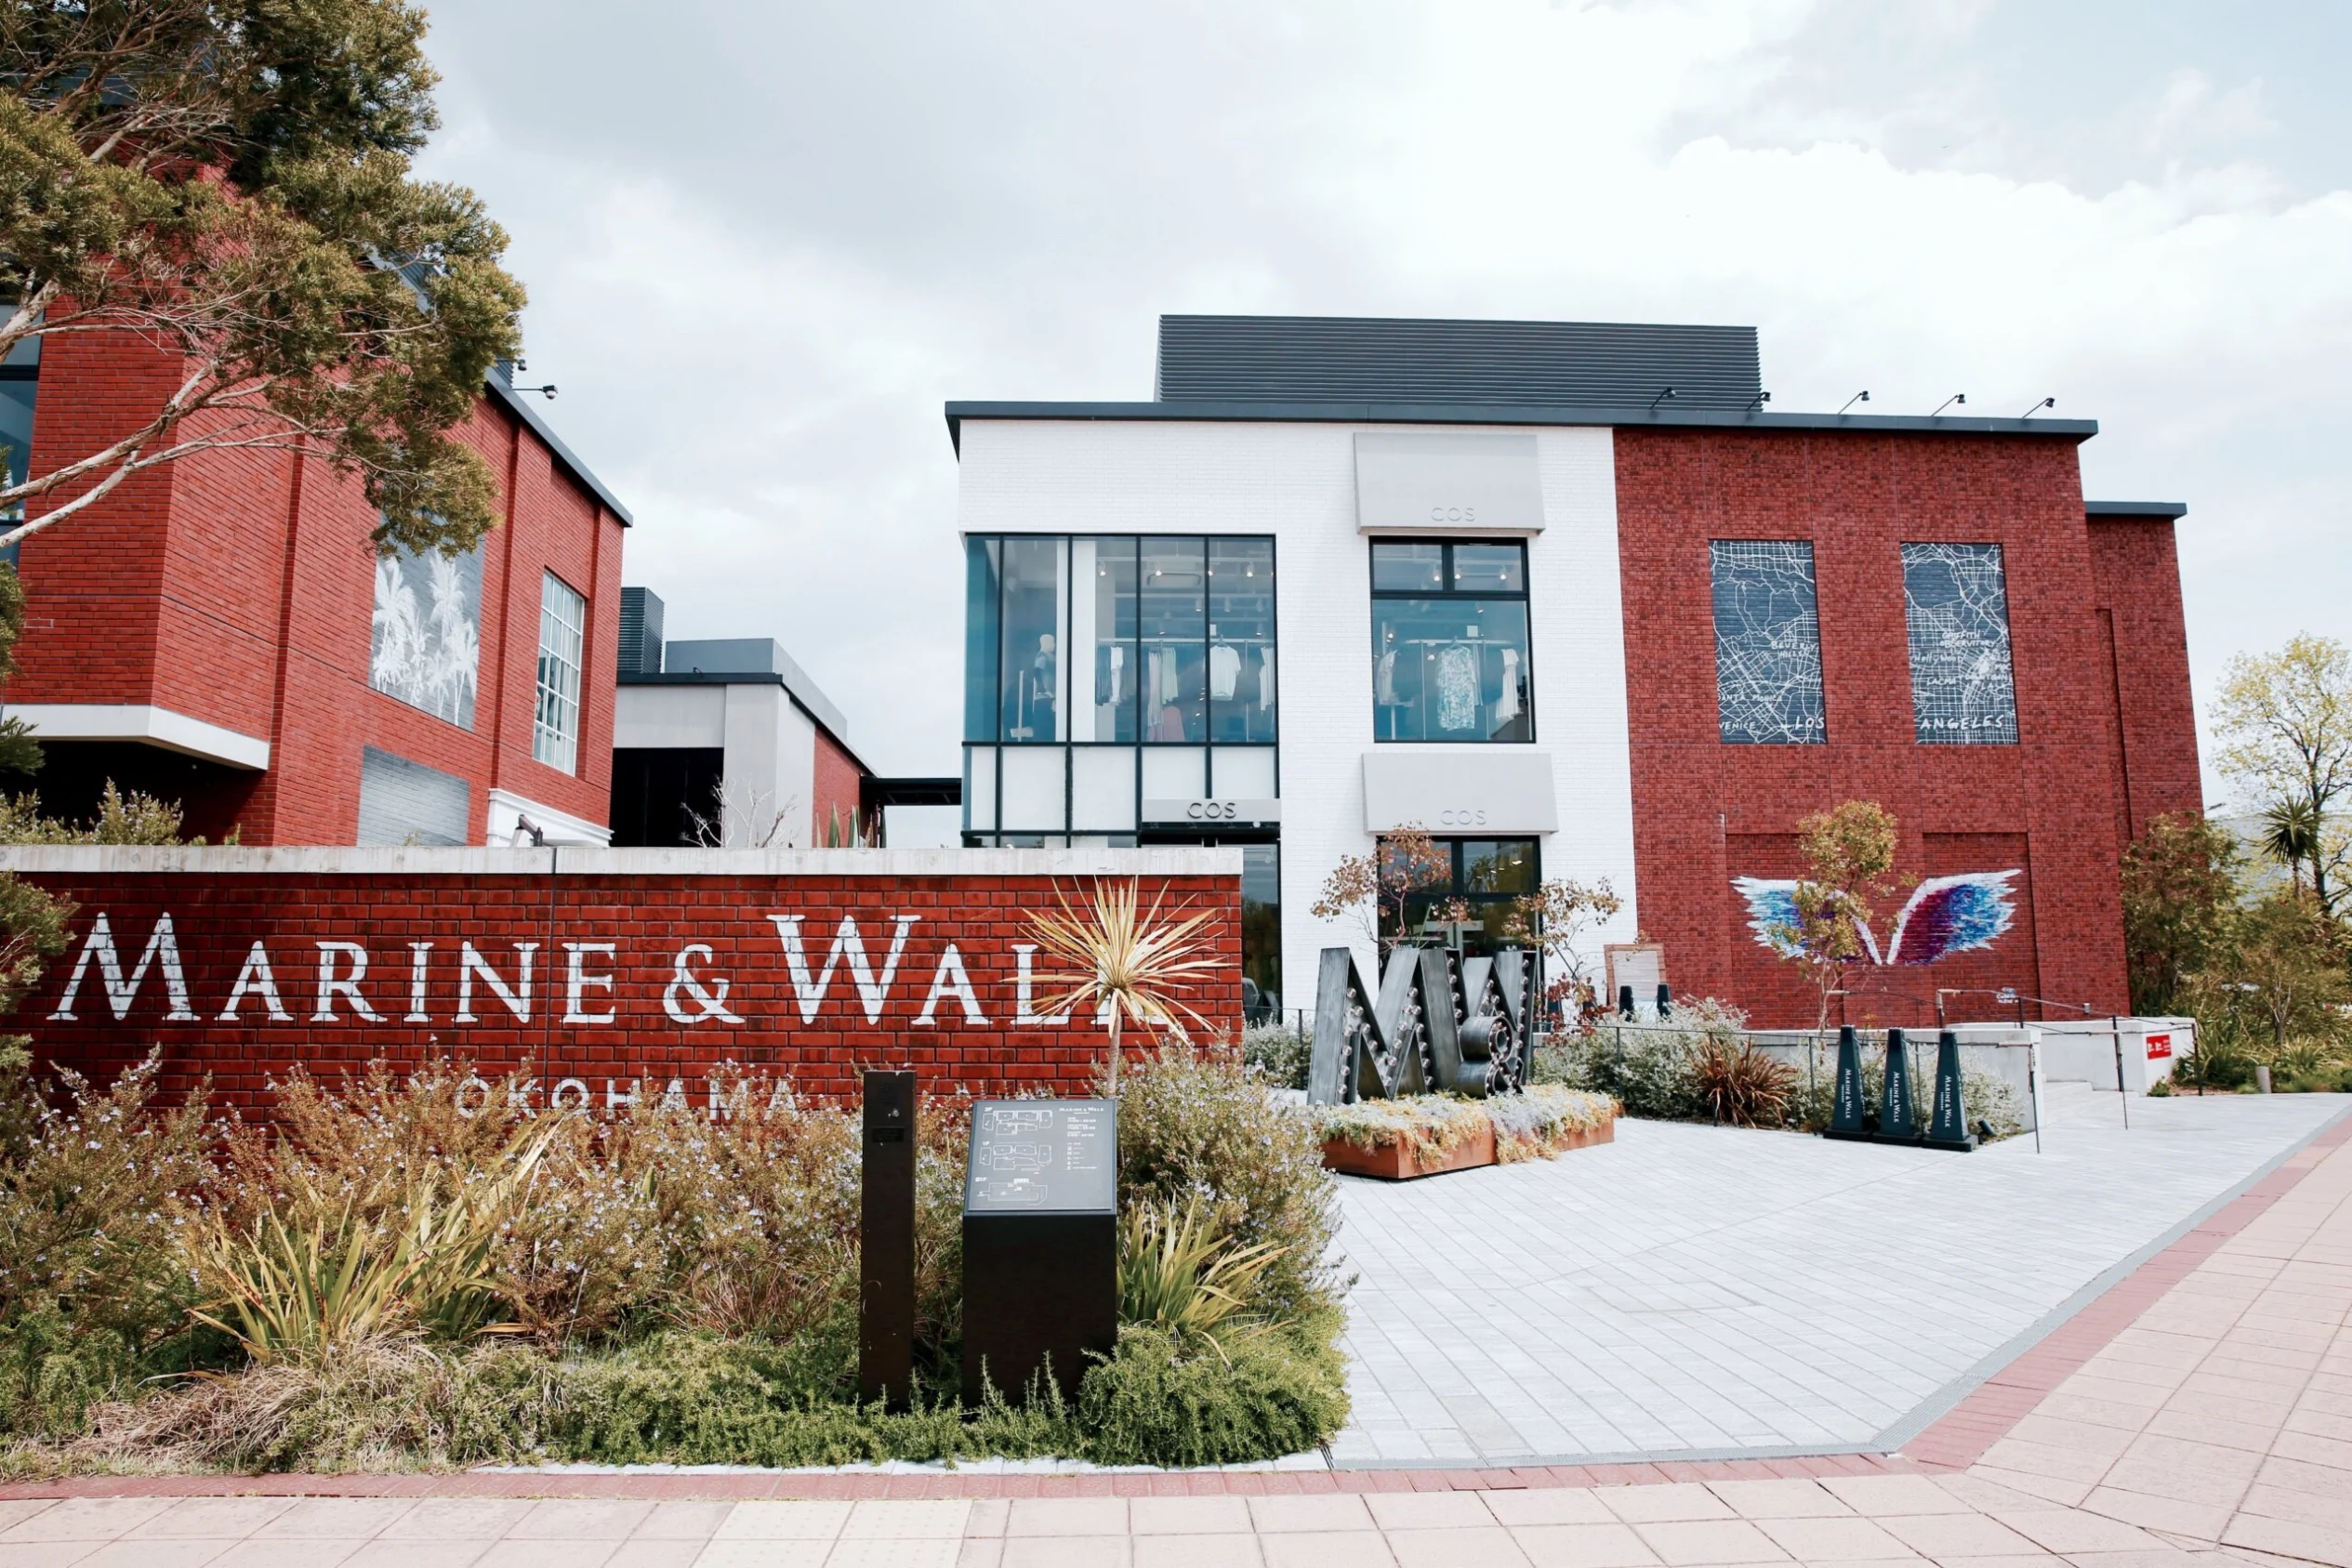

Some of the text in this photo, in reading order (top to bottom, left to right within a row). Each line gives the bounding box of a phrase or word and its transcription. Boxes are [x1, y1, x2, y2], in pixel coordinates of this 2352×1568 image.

[1431, 507, 1476, 521] COS
[1719, 720, 1756, 731] VENICE
[1794, 716, 1824, 730] LOS
[1920, 715, 2004, 730] ANGELES
[1187, 802, 1236, 819] COS
[1440, 810, 1487, 825] COS
[46, 911, 615, 1023] MARINE
[663, 943, 745, 1023] &
